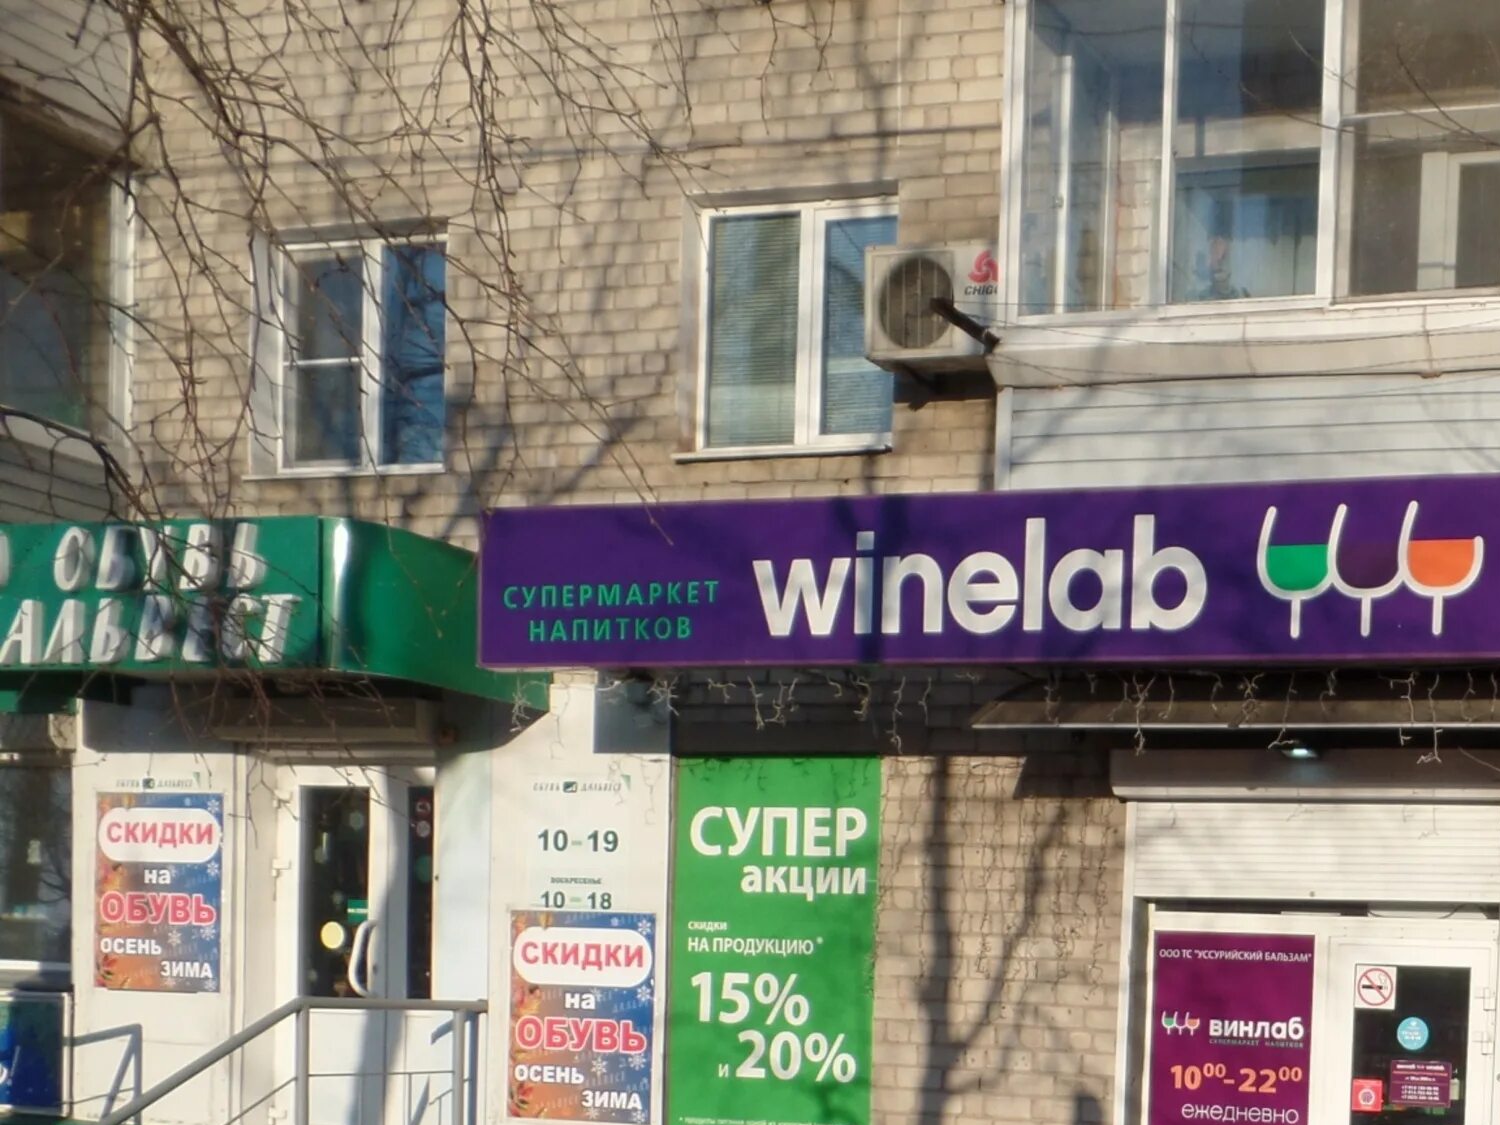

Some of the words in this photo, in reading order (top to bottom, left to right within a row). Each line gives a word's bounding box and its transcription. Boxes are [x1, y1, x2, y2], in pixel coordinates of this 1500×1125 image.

[53, 522, 268, 592] ОБУВЬ
[752, 514, 1207, 636] winelab
[503, 579, 719, 609] СУПЕРМАРКЕТ
[529, 616, 692, 643] НАПИТКОВ
[106, 822, 213, 848] СКИДКИ
[689, 806, 868, 857] СУПЕР
[143, 868, 171, 884] на
[740, 865, 868, 902] акции
[100, 890, 217, 926] ОБУВЬ
[687, 921, 728, 932] скидки
[100, 938, 163, 955] ОСЕНЬ
[521, 942, 644, 971] СКИДКИ
[687, 937, 709, 952] НА
[1159, 949, 1180, 958] ООО
[1182, 949, 1193, 959] ТС
[160, 961, 214, 979] ЗИМА
[565, 992, 596, 1010] на
[691, 972, 810, 1026] 15%
[515, 1015, 647, 1054] ОБУВЬ
[1209, 1016, 1305, 1040] винлаб
[718, 1065, 729, 1078] и
[736, 1030, 857, 1083] 20%
[514, 1064, 585, 1085] ОСЕНЬ
[581, 1090, 643, 1111] ЗИМА
[1181, 1104, 1300, 1125] ежедневно
